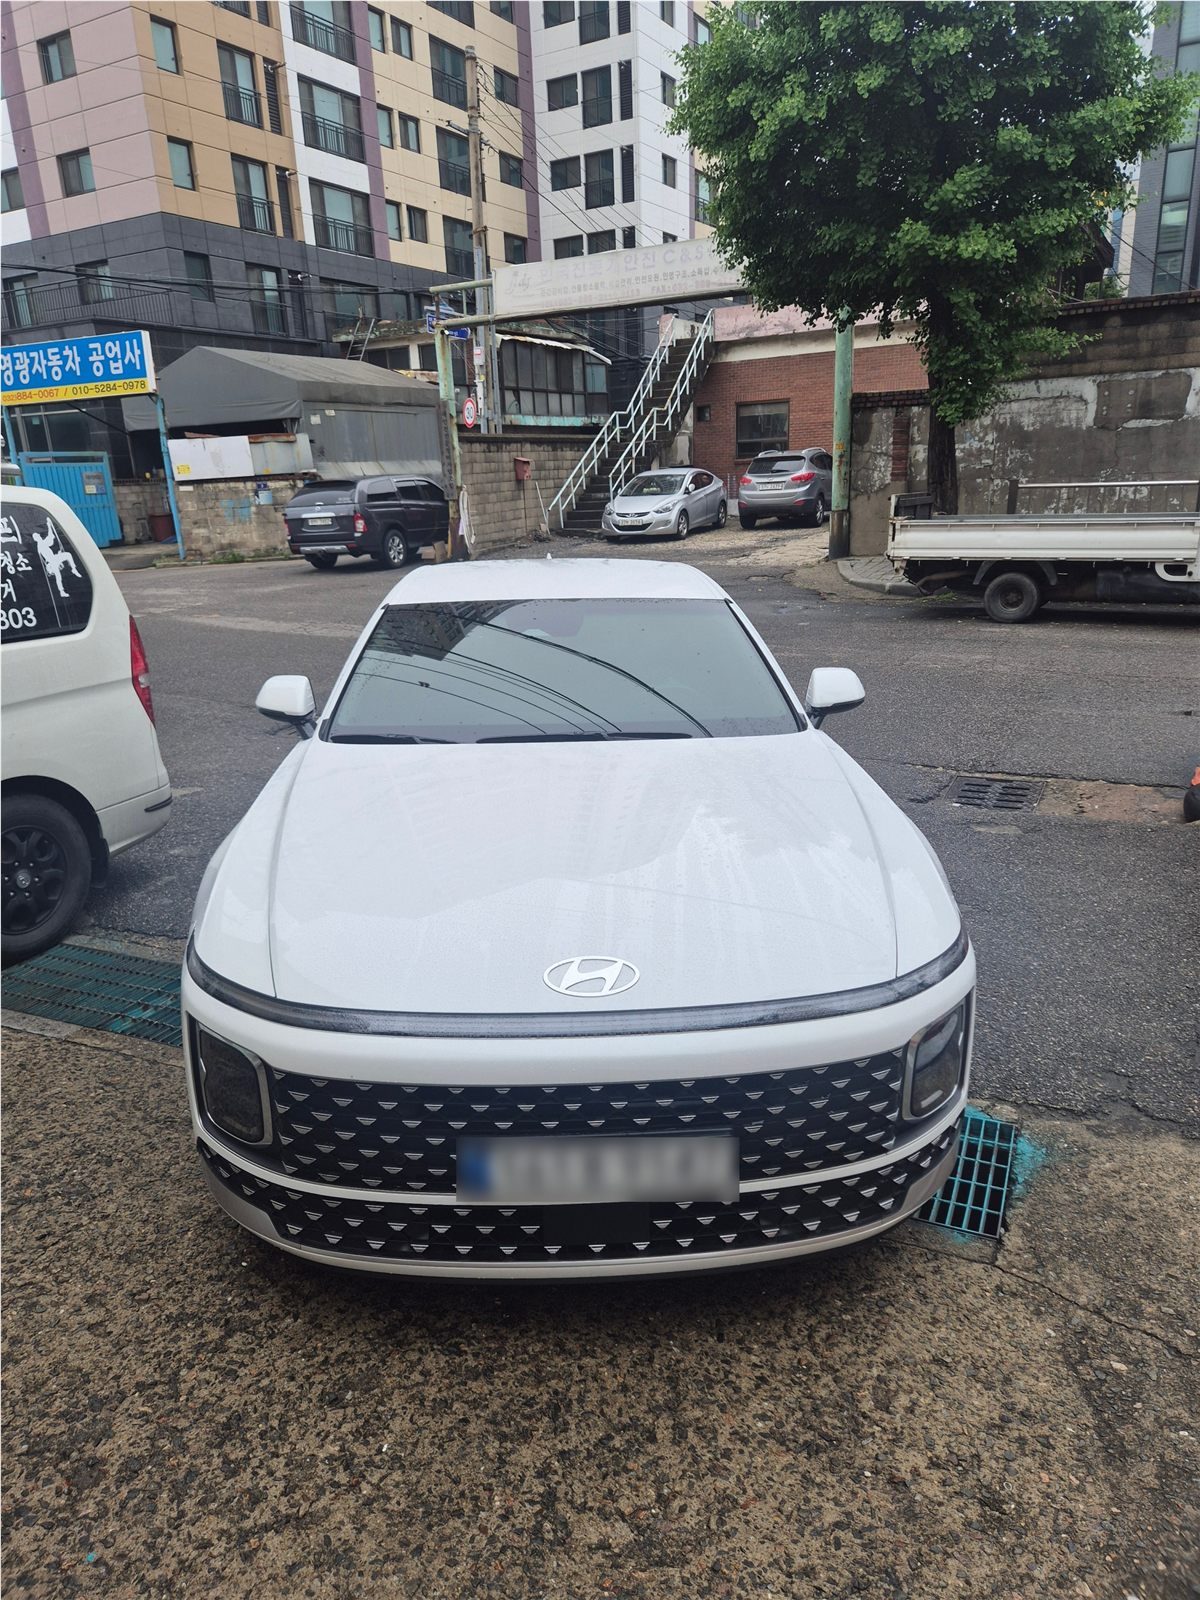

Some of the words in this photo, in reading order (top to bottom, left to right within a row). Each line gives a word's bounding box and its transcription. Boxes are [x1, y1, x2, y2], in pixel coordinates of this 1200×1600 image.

[1, 345, 81, 386] 영광자동차
[88, 339, 141, 377] 공업사
[72, 380, 146, 396] 010-5284-0978
